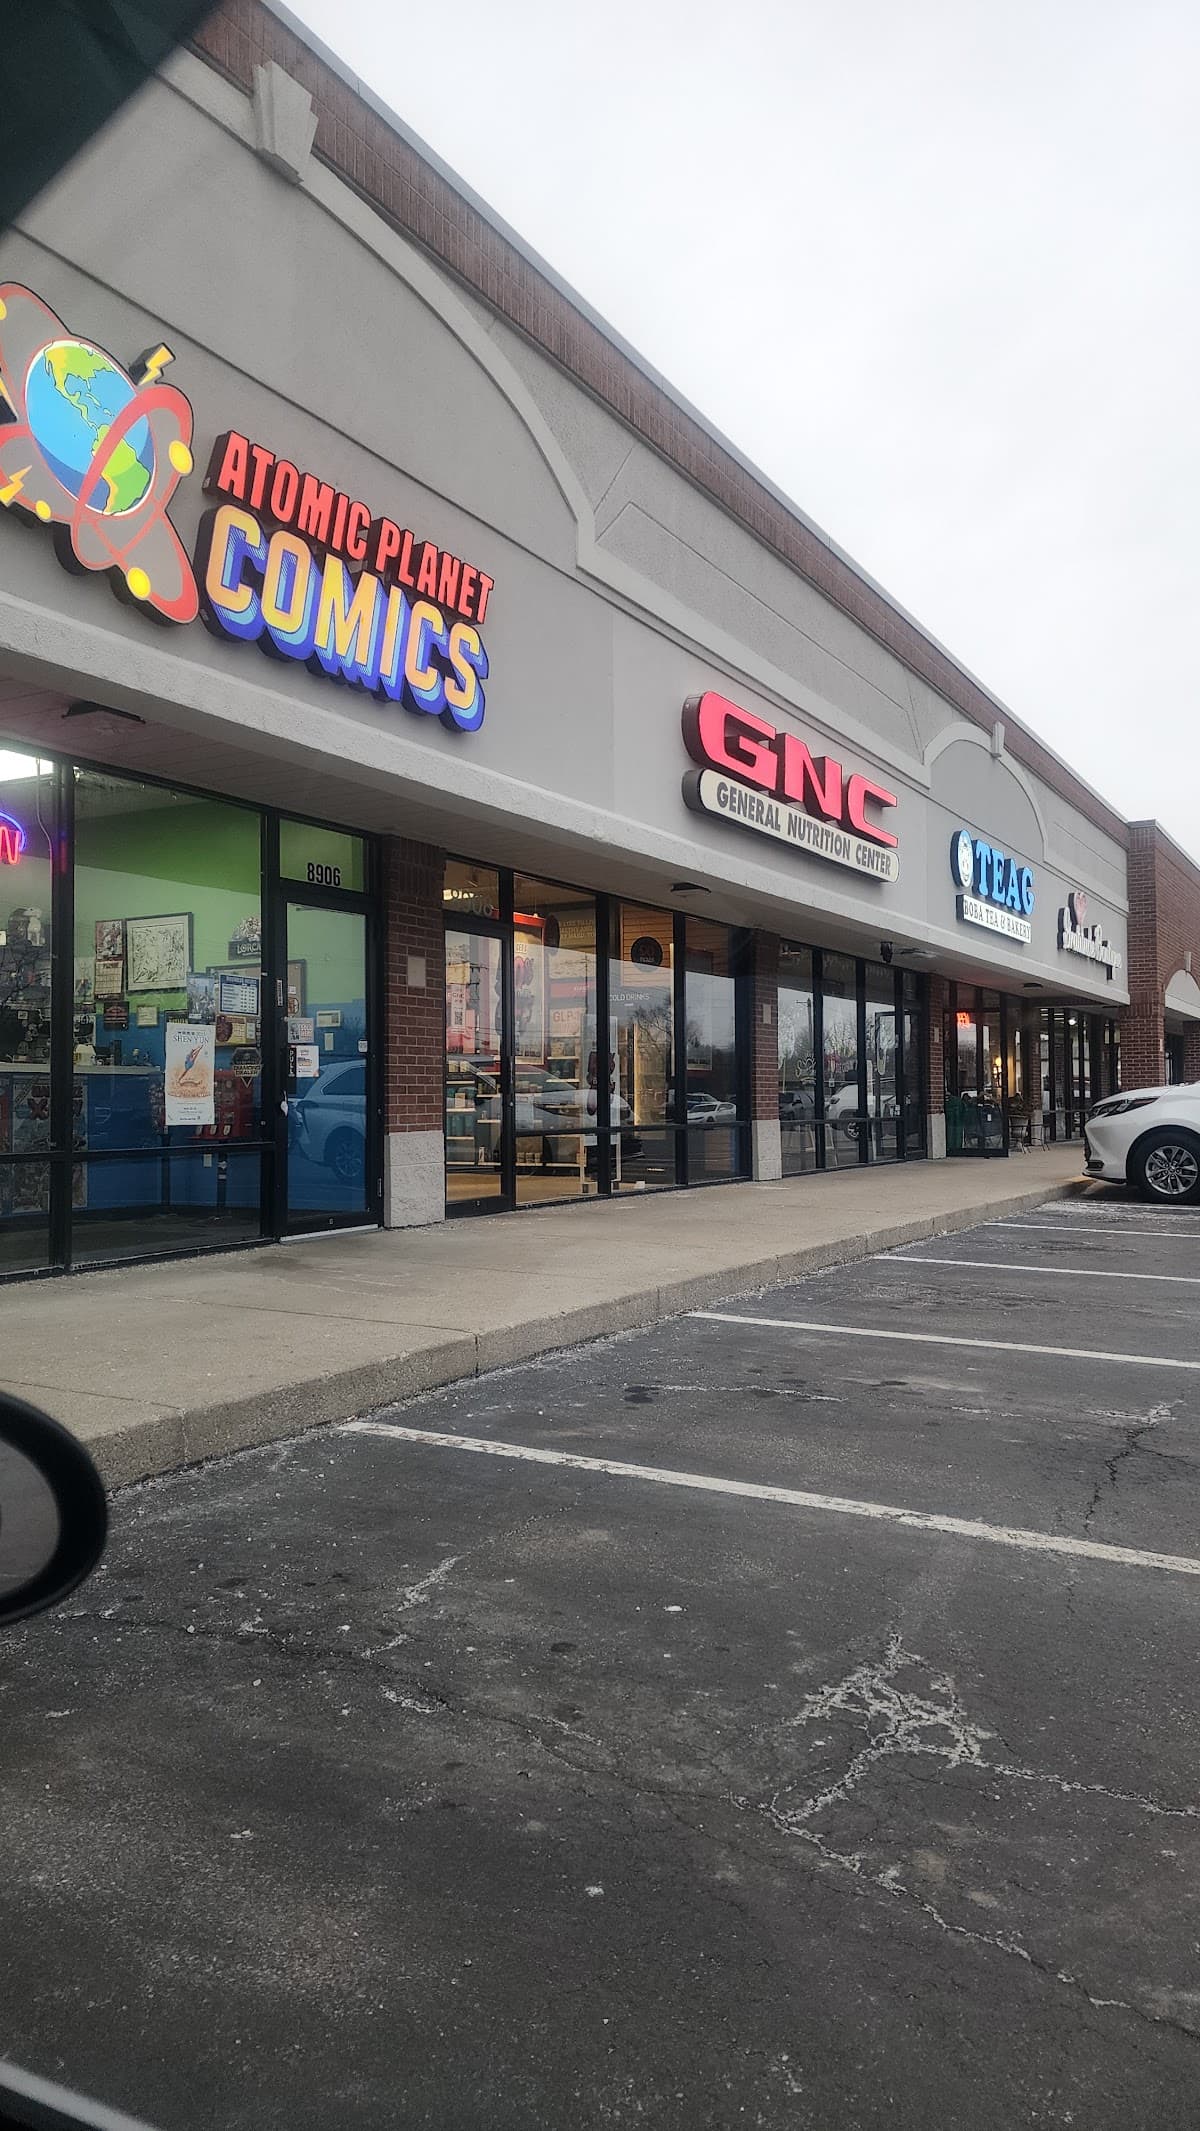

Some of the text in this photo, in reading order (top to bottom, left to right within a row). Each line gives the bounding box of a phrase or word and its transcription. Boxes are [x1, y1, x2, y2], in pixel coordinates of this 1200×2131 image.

[216, 430, 495, 625] ATOMIC PLANET
[205, 503, 486, 725] COMICS
[698, 690, 899, 849] GNC
[716, 781, 891, 876] GENERAL NUTRITION CENTER
[307, 862, 341, 887] 8906
[976, 839, 1035, 916] TEAG
[964, 899, 984, 922] BOBA
[985, 908, 999, 928] TEA
[1006, 916, 1031, 940] BAKERY
[625, 992, 650, 1002] DRINKS
